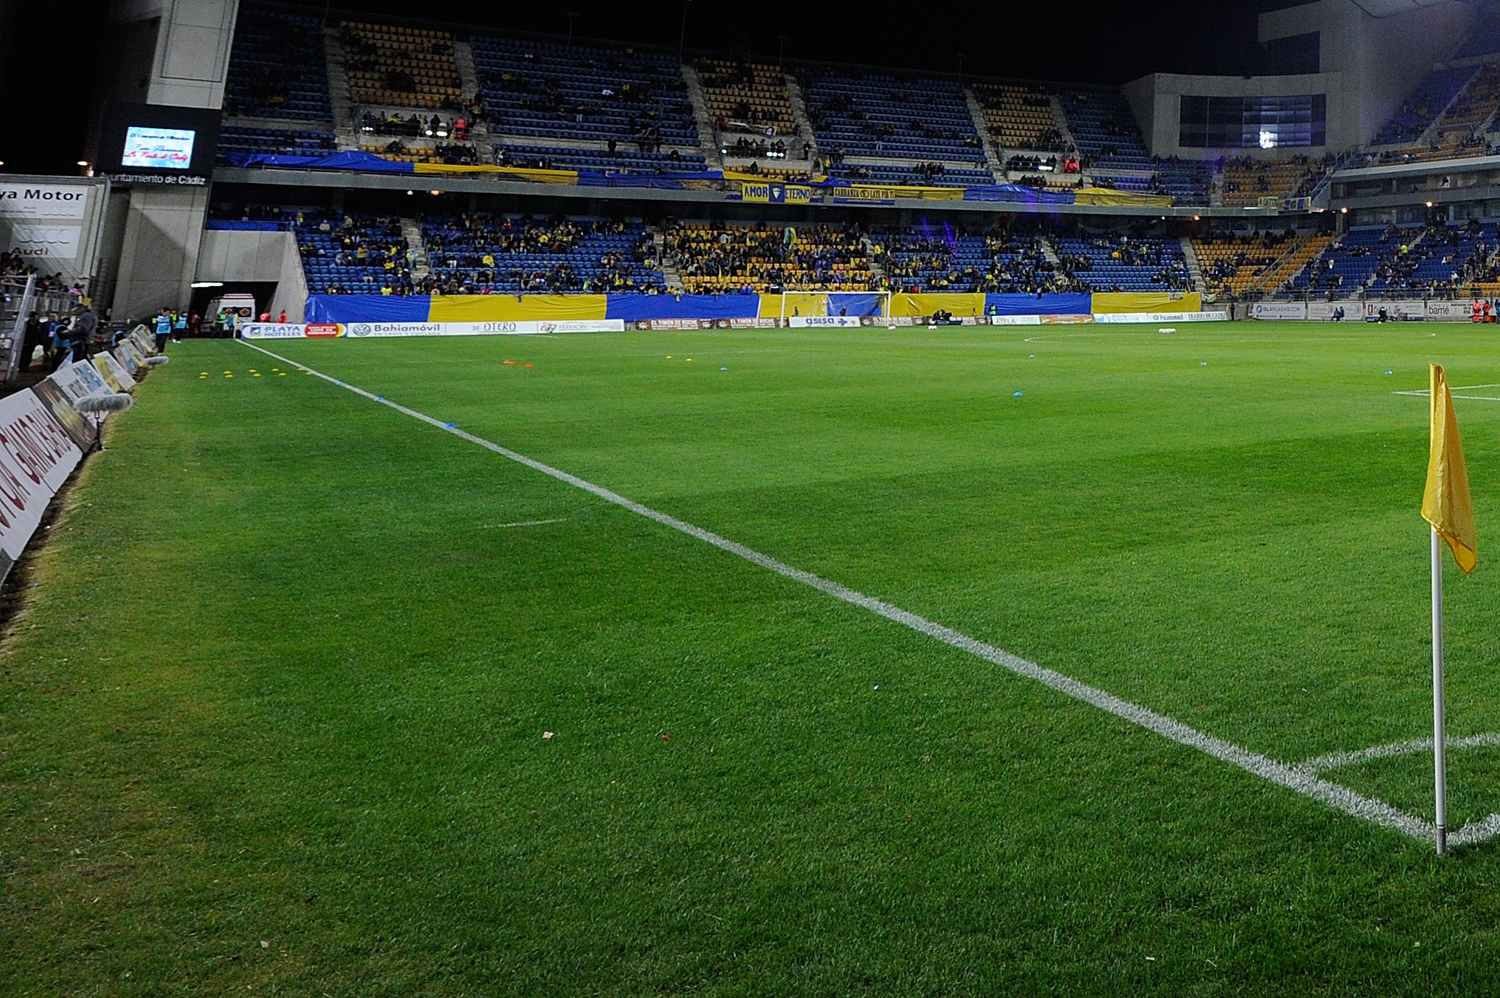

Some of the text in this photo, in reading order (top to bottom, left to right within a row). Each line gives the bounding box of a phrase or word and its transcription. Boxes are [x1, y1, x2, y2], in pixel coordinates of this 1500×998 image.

[100, 172, 206, 185] Ayuntamiento de Cádiz
[24, 189, 83, 201] Motor
[744, 183, 811, 199] AMOR ETERNO
[11, 247, 49, 256] Audi
[805, 317, 835, 325] asisa
[483, 322, 517, 332] OTERO
